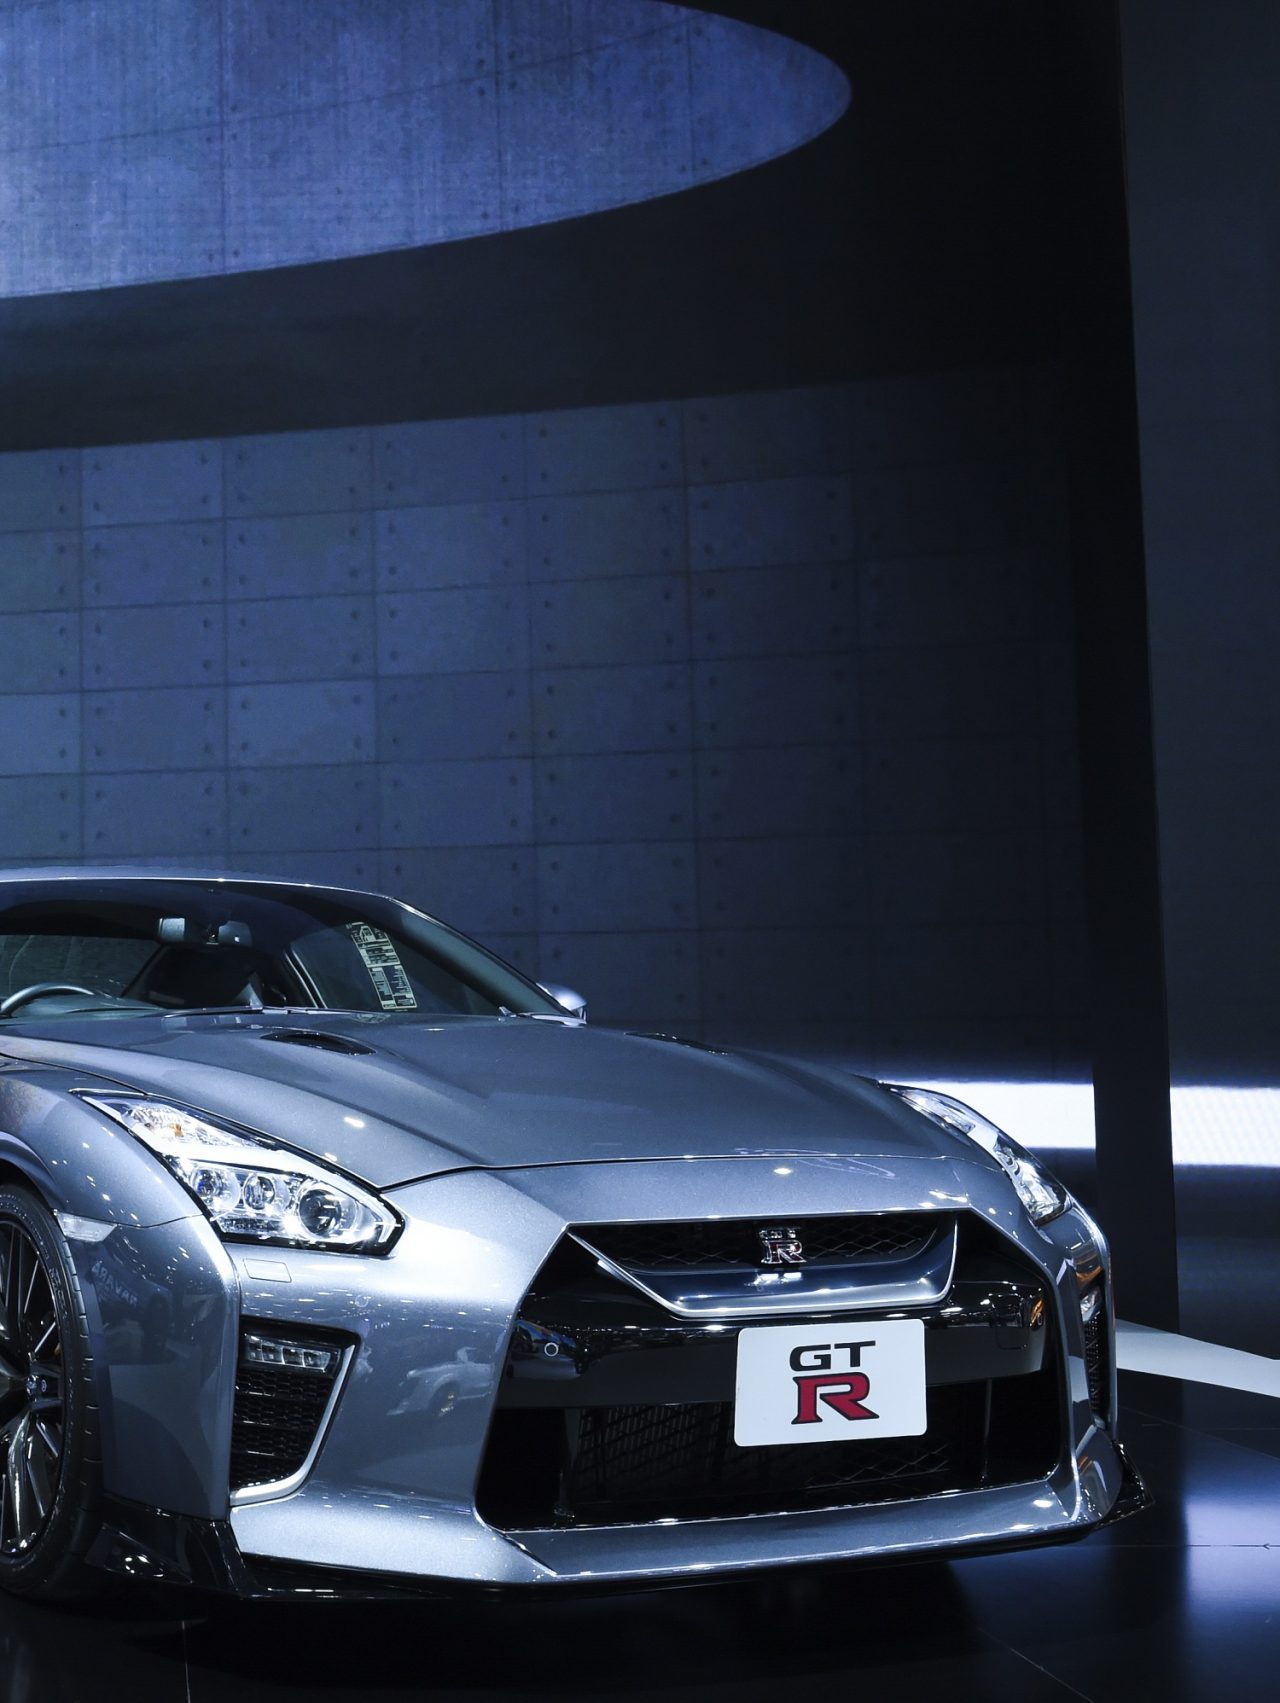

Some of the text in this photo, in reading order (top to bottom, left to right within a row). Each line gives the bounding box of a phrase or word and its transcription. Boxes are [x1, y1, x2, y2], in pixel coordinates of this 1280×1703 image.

[761, 1240, 807, 1264] R
[789, 1340, 876, 1372] GT
[791, 1371, 880, 1425] R
